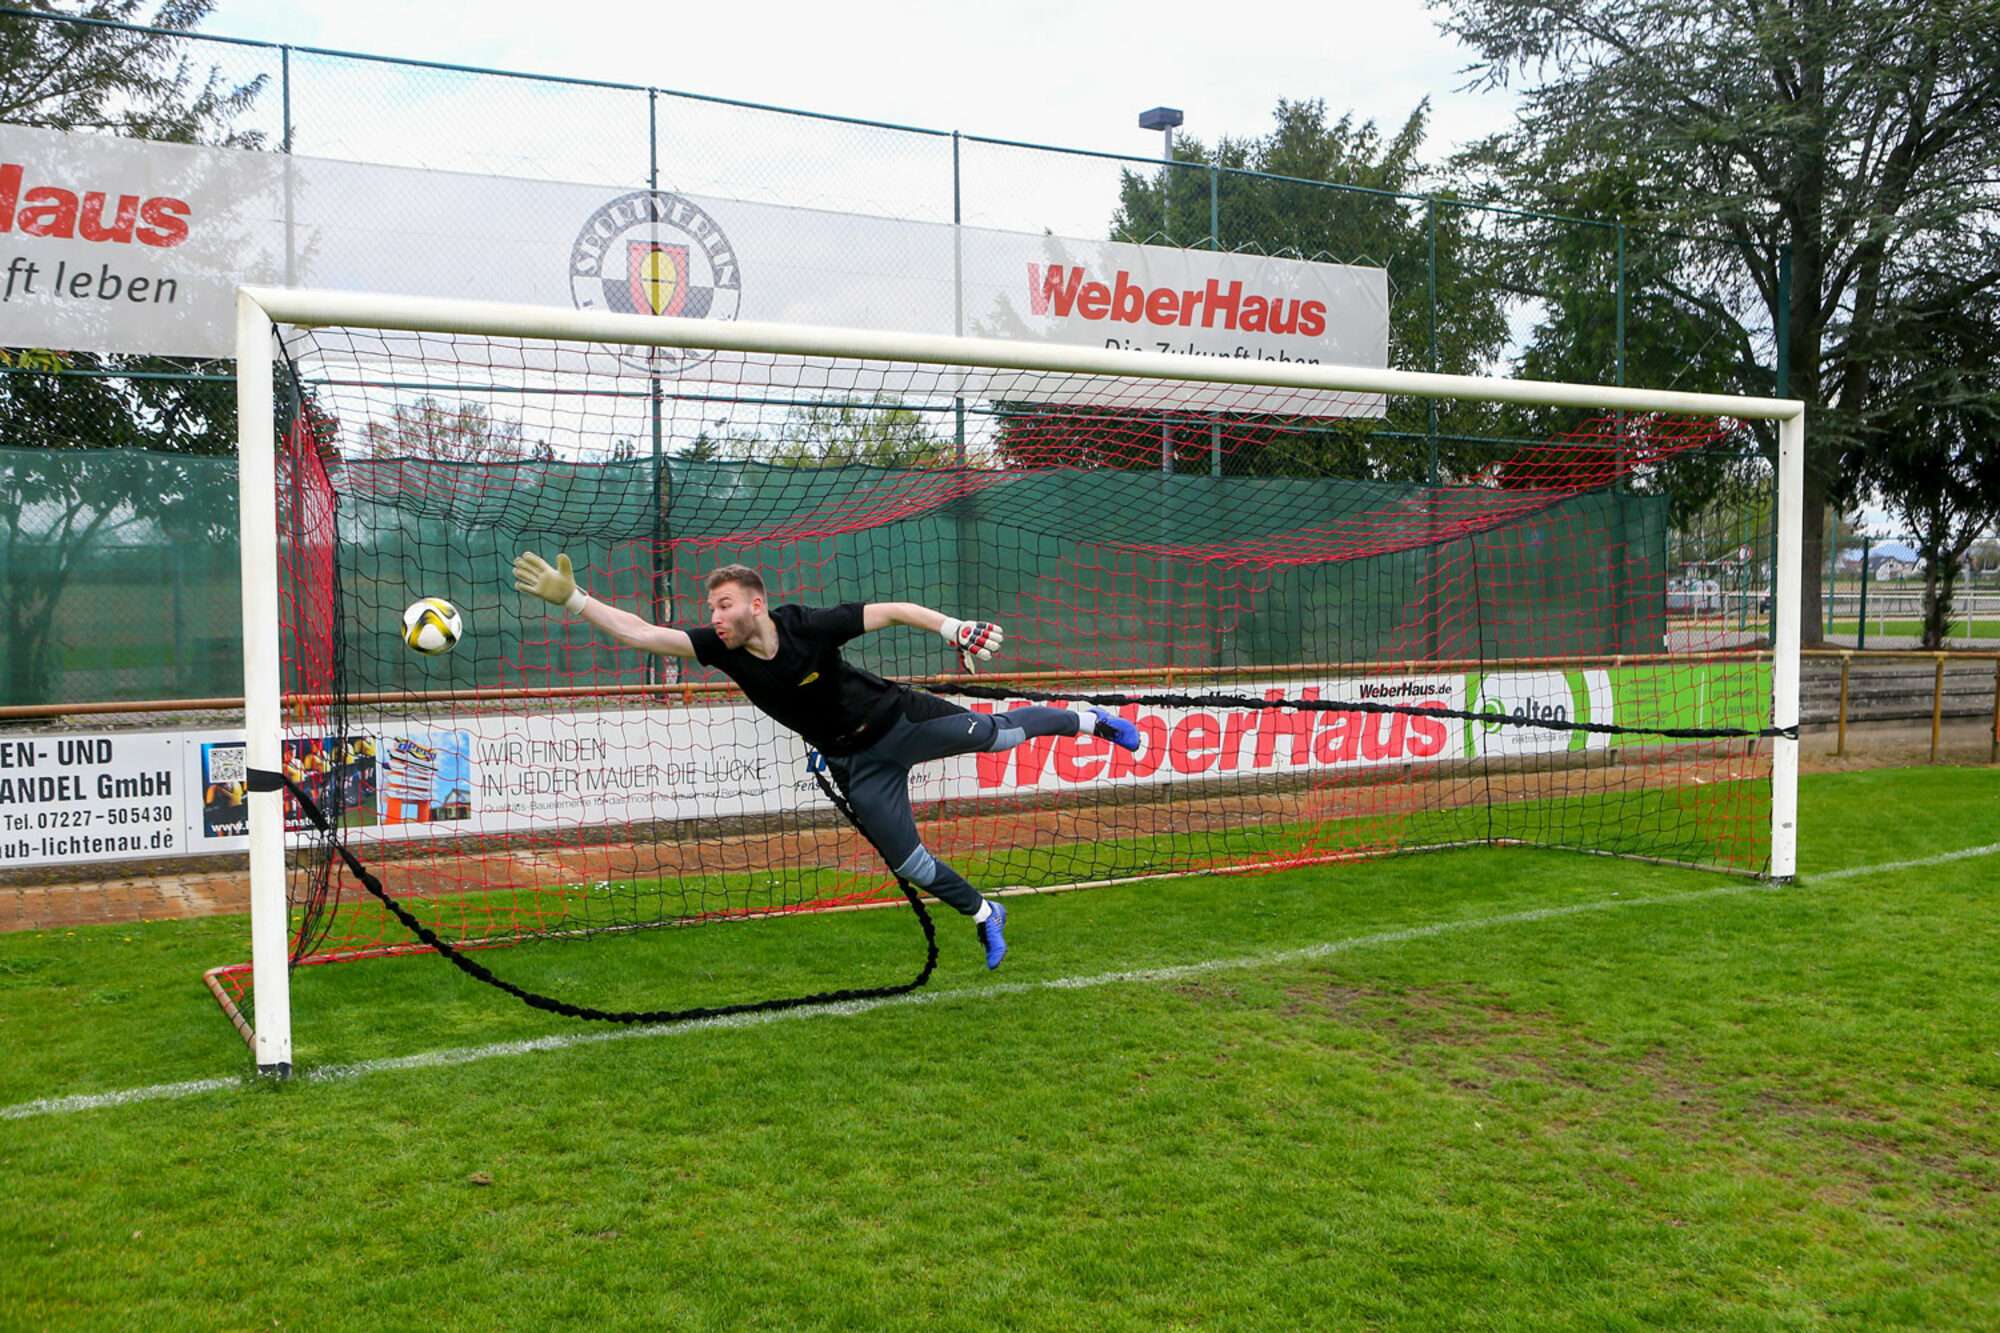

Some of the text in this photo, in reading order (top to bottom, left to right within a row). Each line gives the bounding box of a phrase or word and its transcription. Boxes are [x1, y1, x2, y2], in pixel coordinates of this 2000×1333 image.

[574, 196, 738, 286] SPORTVEREIN
[55, 261, 178, 303] leben
[1027, 262, 1326, 337] WeberHaus
[1360, 682, 1452, 698] WeberHaus.de
[0, 739, 113, 768] EN- UND
[482, 737, 607, 766] WIR FINDEN
[970, 687, 1449, 789] WeberHaus
[0, 771, 171, 804] ANDEL GmbH
[483, 755, 773, 798] IN JEDER MAUER DIE LÜCKE.
[4, 814, 33, 831] Tel.
